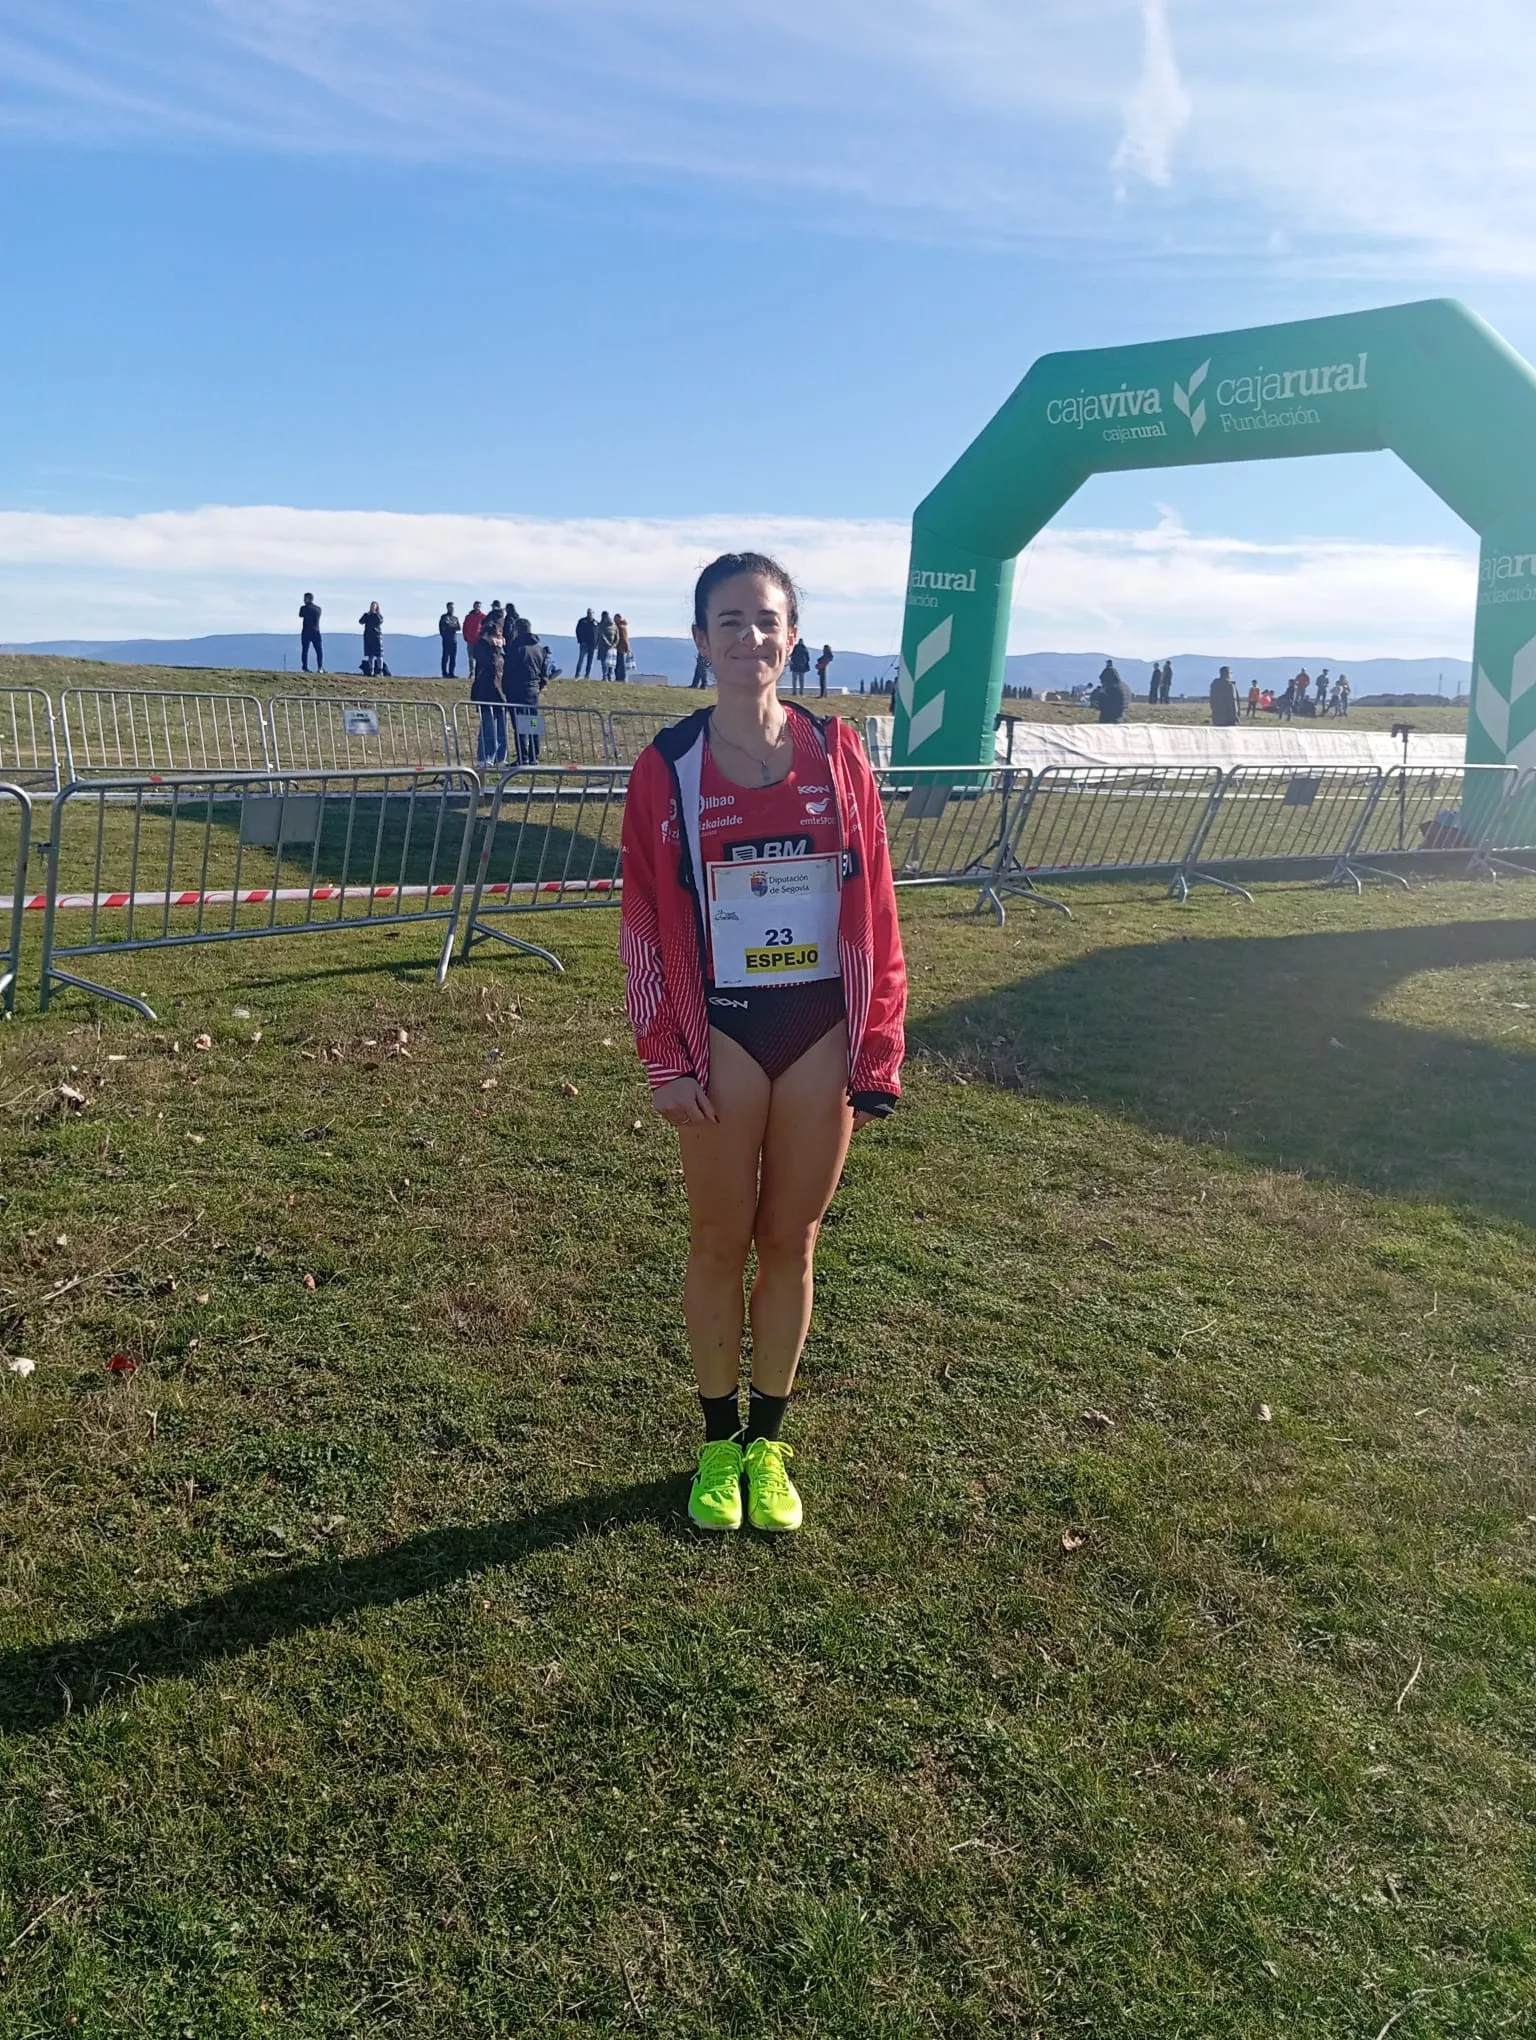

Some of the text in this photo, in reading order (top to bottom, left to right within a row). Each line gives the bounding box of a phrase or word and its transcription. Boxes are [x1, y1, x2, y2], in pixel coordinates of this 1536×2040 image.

[1216, 352, 1368, 411] cajarural
[1047, 383, 1162, 430] cajaviva
[1220, 405, 1320, 432] Fundación
[1103, 421, 1167, 443] cajarural
[701, 815, 743, 831] zkaialde
[769, 874, 809, 885] Diputación
[781, 884, 810, 895] Segovia
[765, 928, 793, 947] 23
[746, 949, 819, 969] ESPEJO
